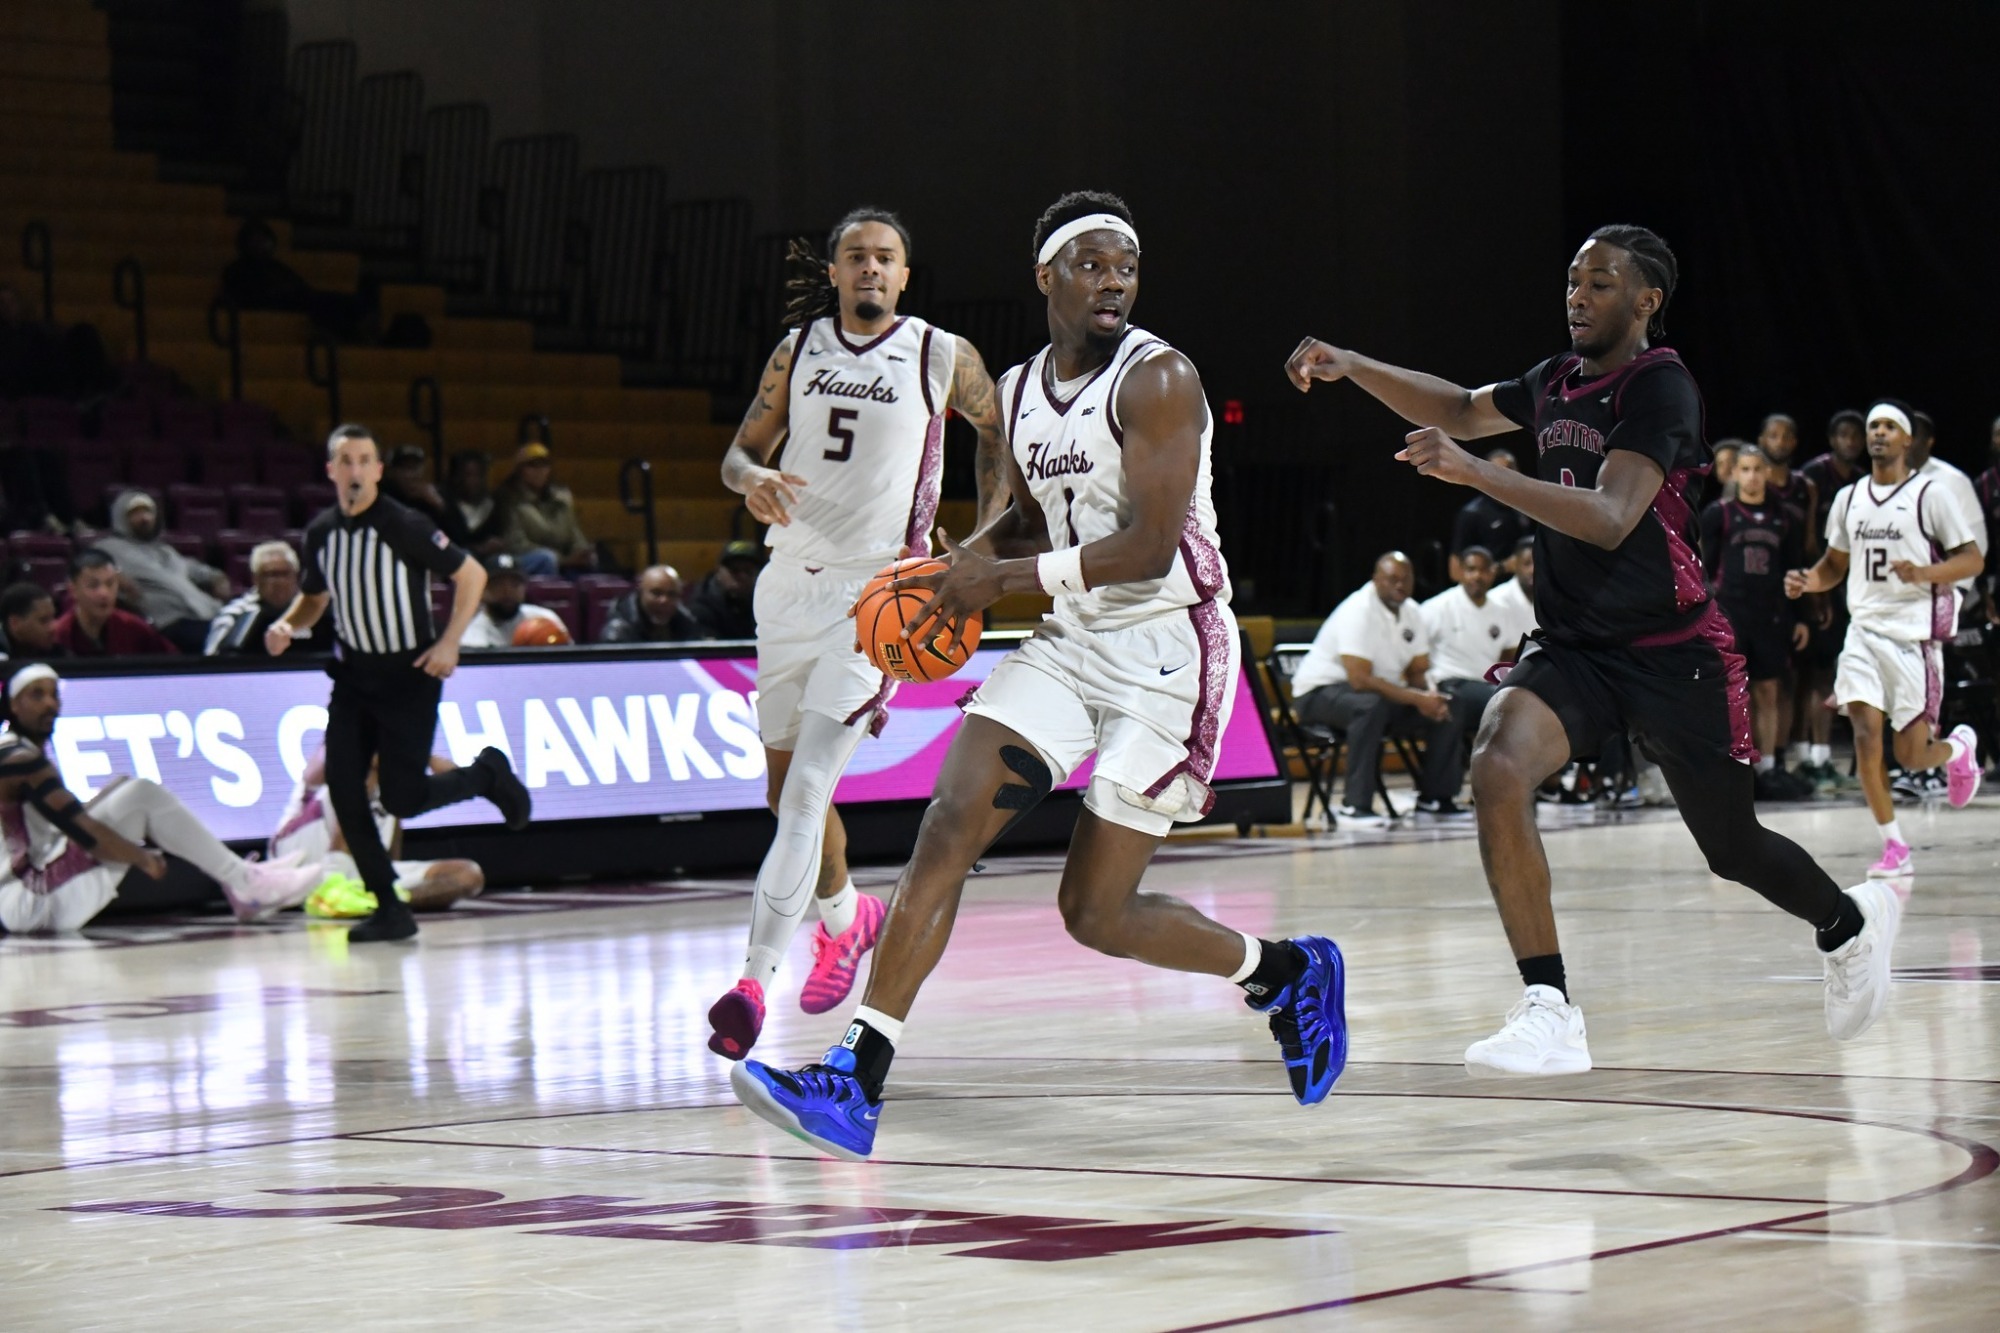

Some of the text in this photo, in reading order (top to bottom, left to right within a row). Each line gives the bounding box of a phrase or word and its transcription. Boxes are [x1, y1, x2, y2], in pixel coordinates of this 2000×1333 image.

[803, 369, 899, 404] Hawks
[823, 407, 860, 463] 5
[1027, 439, 1094, 481] Hawks
[1064, 487, 1080, 548] 1
[1854, 519, 1903, 541] Hawks
[1865, 548, 1887, 581] 12
[884, 643, 919, 684] ELIT
[51, 708, 263, 807] ET'S
